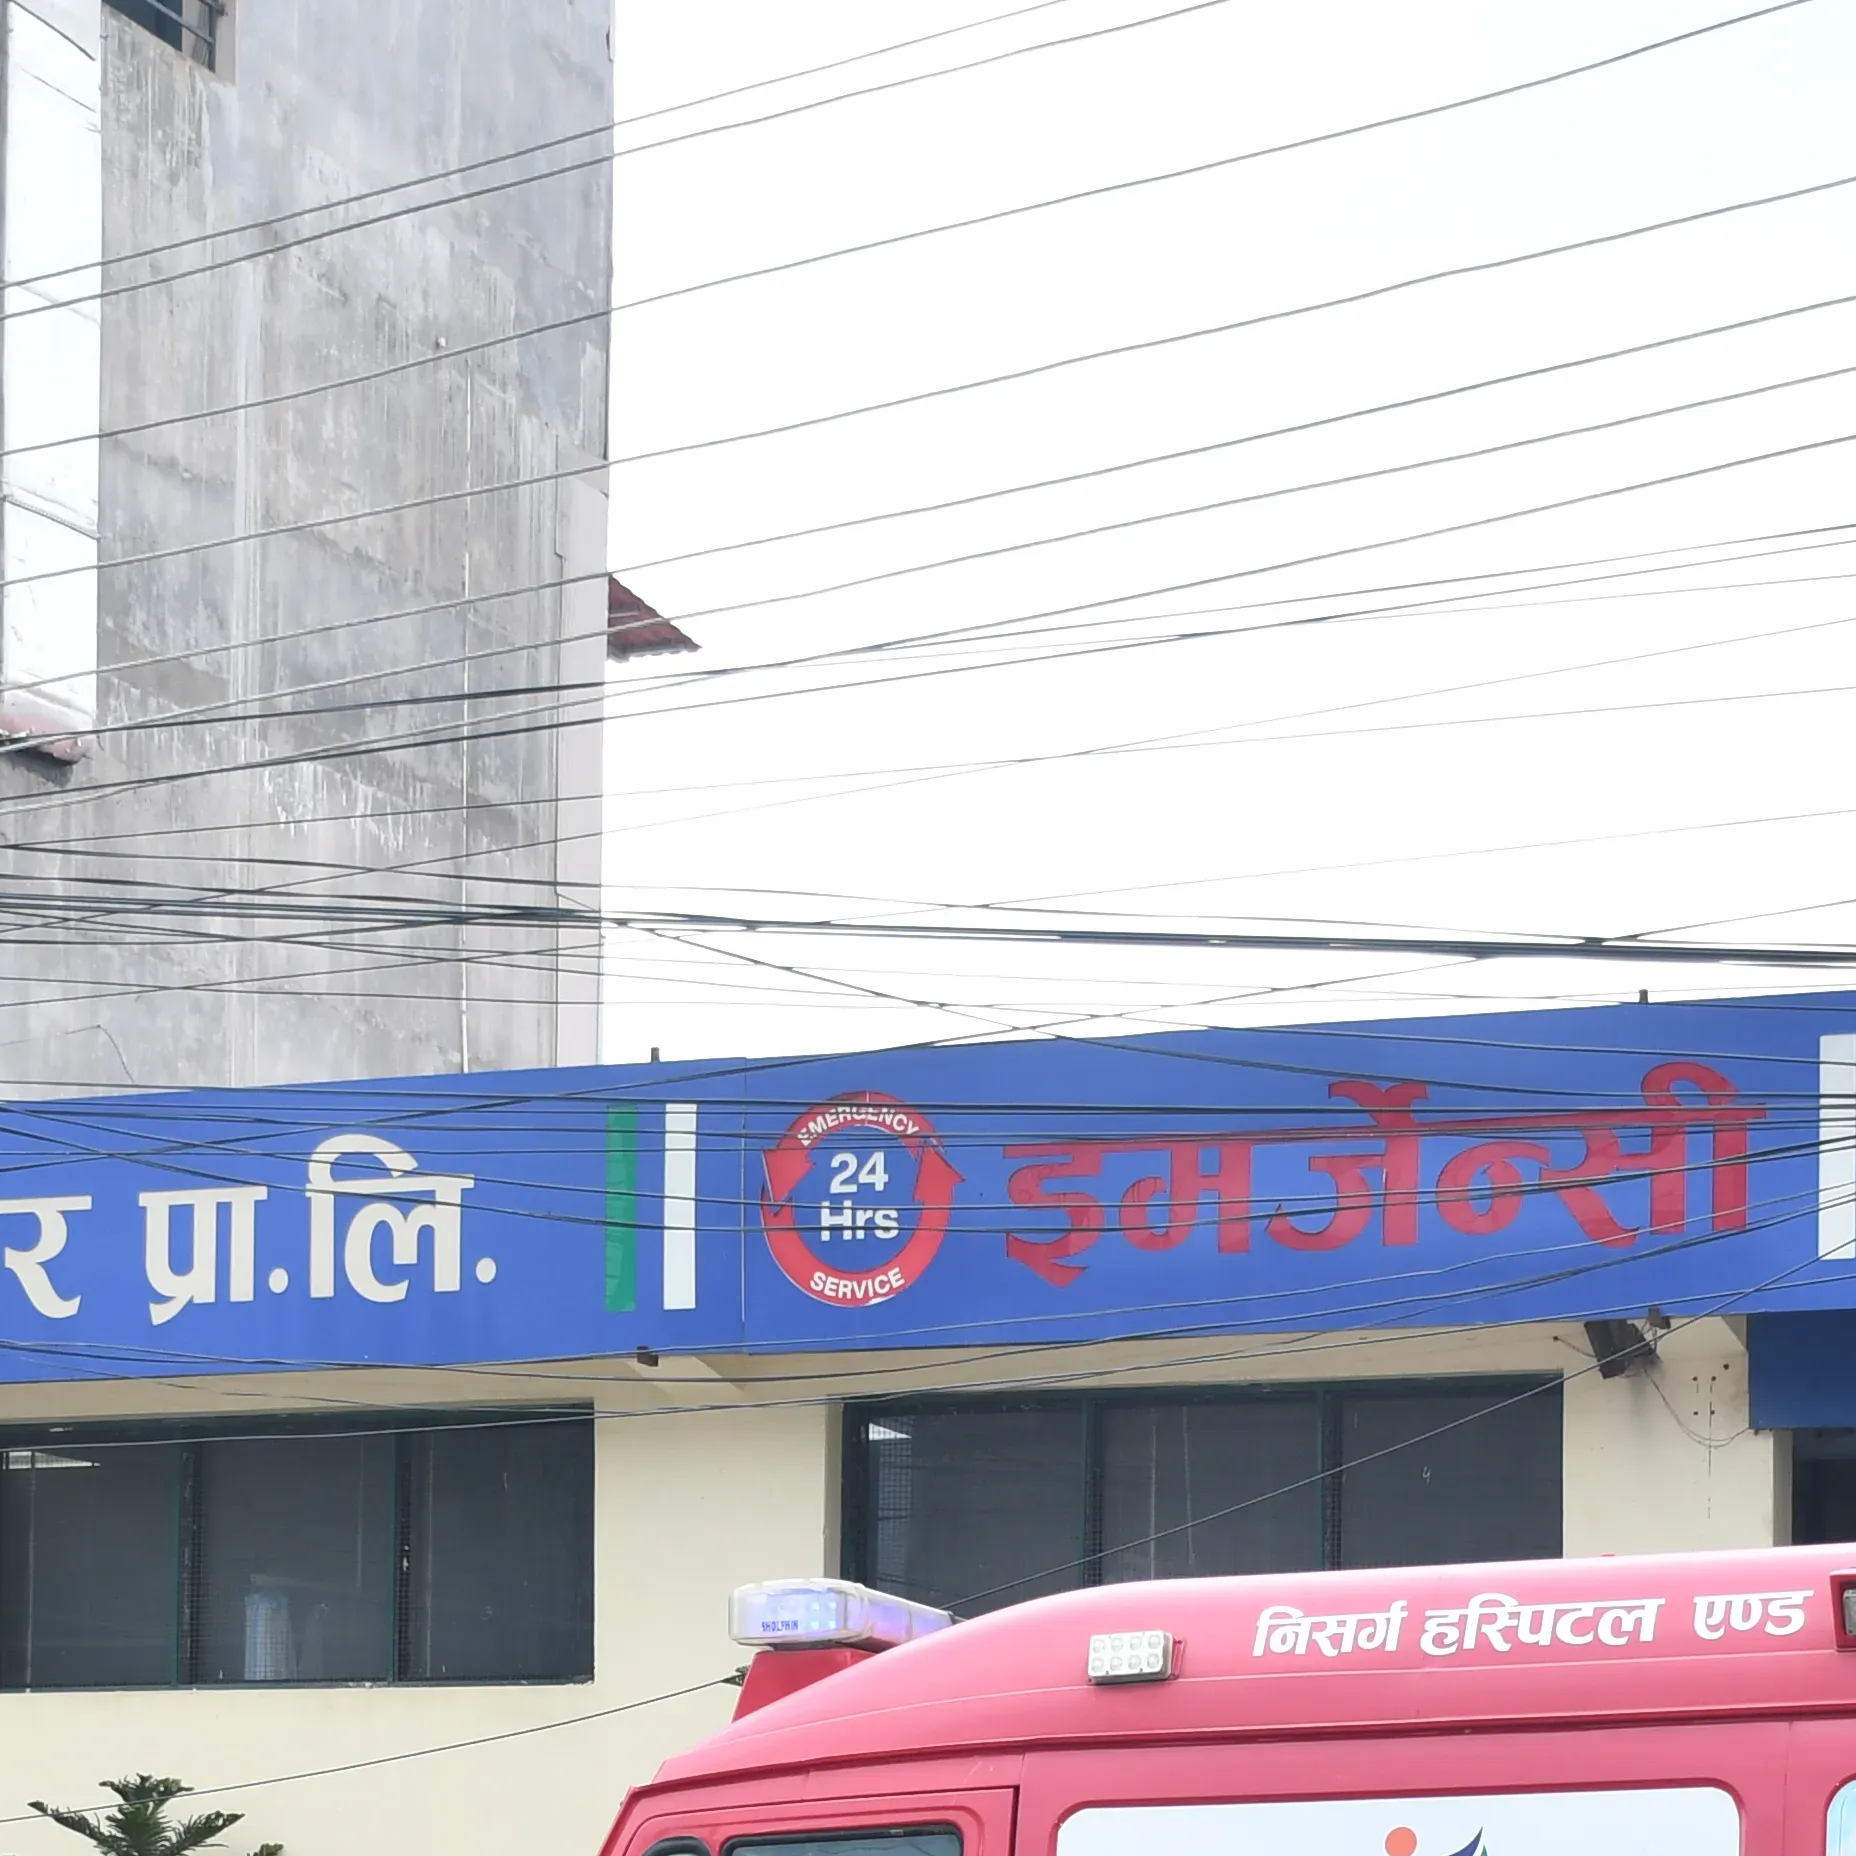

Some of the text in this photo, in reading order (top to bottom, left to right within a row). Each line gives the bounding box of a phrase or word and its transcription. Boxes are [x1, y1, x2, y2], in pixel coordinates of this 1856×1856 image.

[797, 1106, 920, 1148] EMERGENCY
[829, 1151, 890, 1194] 24
[820, 1199, 900, 1242] Hrs
[809, 1266, 906, 1300] SERVICE
[1252, 1600, 1406, 1657] निसर्ग
[1420, 1593, 1664, 1656] हस्पिटल
[1692, 1588, 1812, 1639] एण्ड
